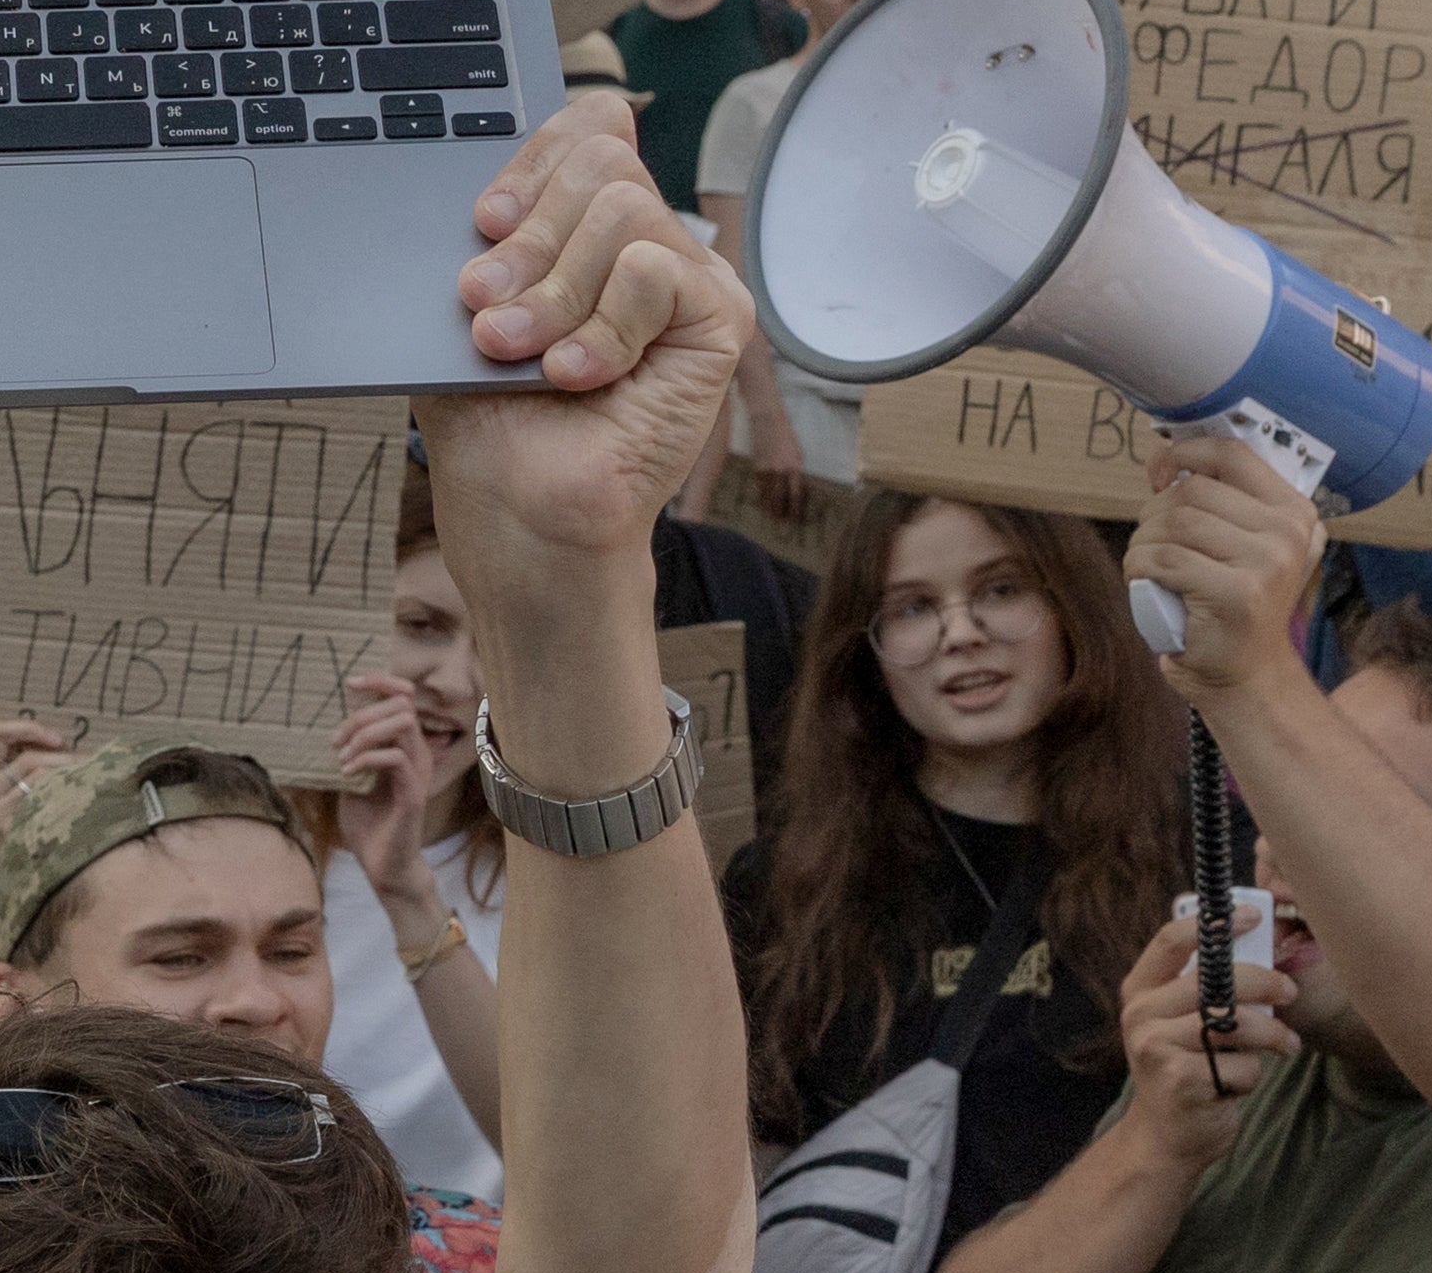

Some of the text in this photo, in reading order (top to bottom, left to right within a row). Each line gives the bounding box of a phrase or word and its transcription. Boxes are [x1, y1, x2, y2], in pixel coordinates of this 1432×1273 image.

[73, 25, 82, 36] J
[140, 23, 151, 34] K
[209, 21, 218, 32] L
[453, 24, 489, 32] return
[4, 28, 16, 38] H
[162, 33, 172, 43] Л
[226, 31, 238, 41] Д
[294, 29, 307, 38] Ж
[41, 73, 53, 84] N
[108, 70, 123, 81] M
[469, 70, 496, 78] shift
[264, 77, 278, 87] Ю
[169, 127, 228, 136] command
[256, 124, 294, 134] option
[1134, 113, 1415, 204] ИГАЛЯ
[956, 376, 1039, 453] НА
